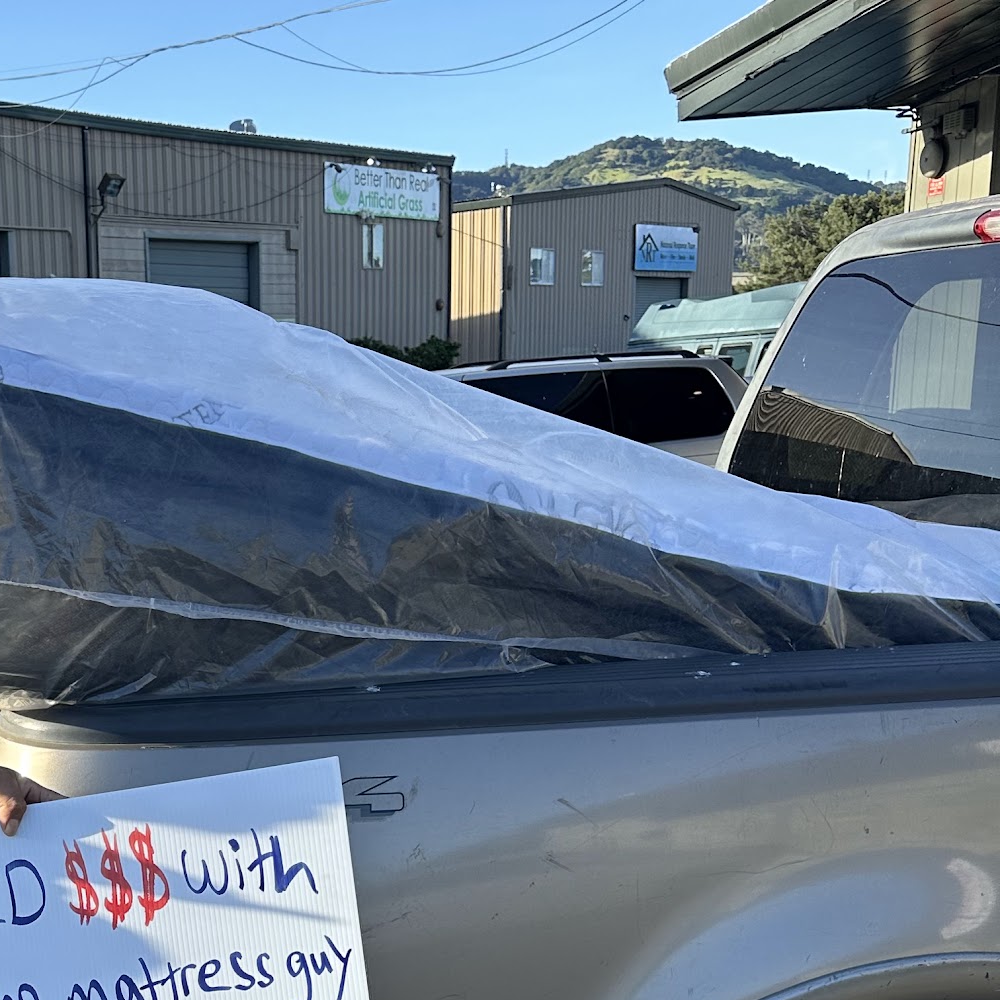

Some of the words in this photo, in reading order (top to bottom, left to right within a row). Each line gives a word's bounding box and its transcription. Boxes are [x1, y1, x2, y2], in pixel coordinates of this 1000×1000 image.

[354, 168, 383, 187] Better
[385, 172, 408, 190] Than
[358, 190, 396, 210] Artificial
[398, 195, 423, 212] Grass
[63, 823, 170, 930] $$$
[181, 828, 319, 896] with
